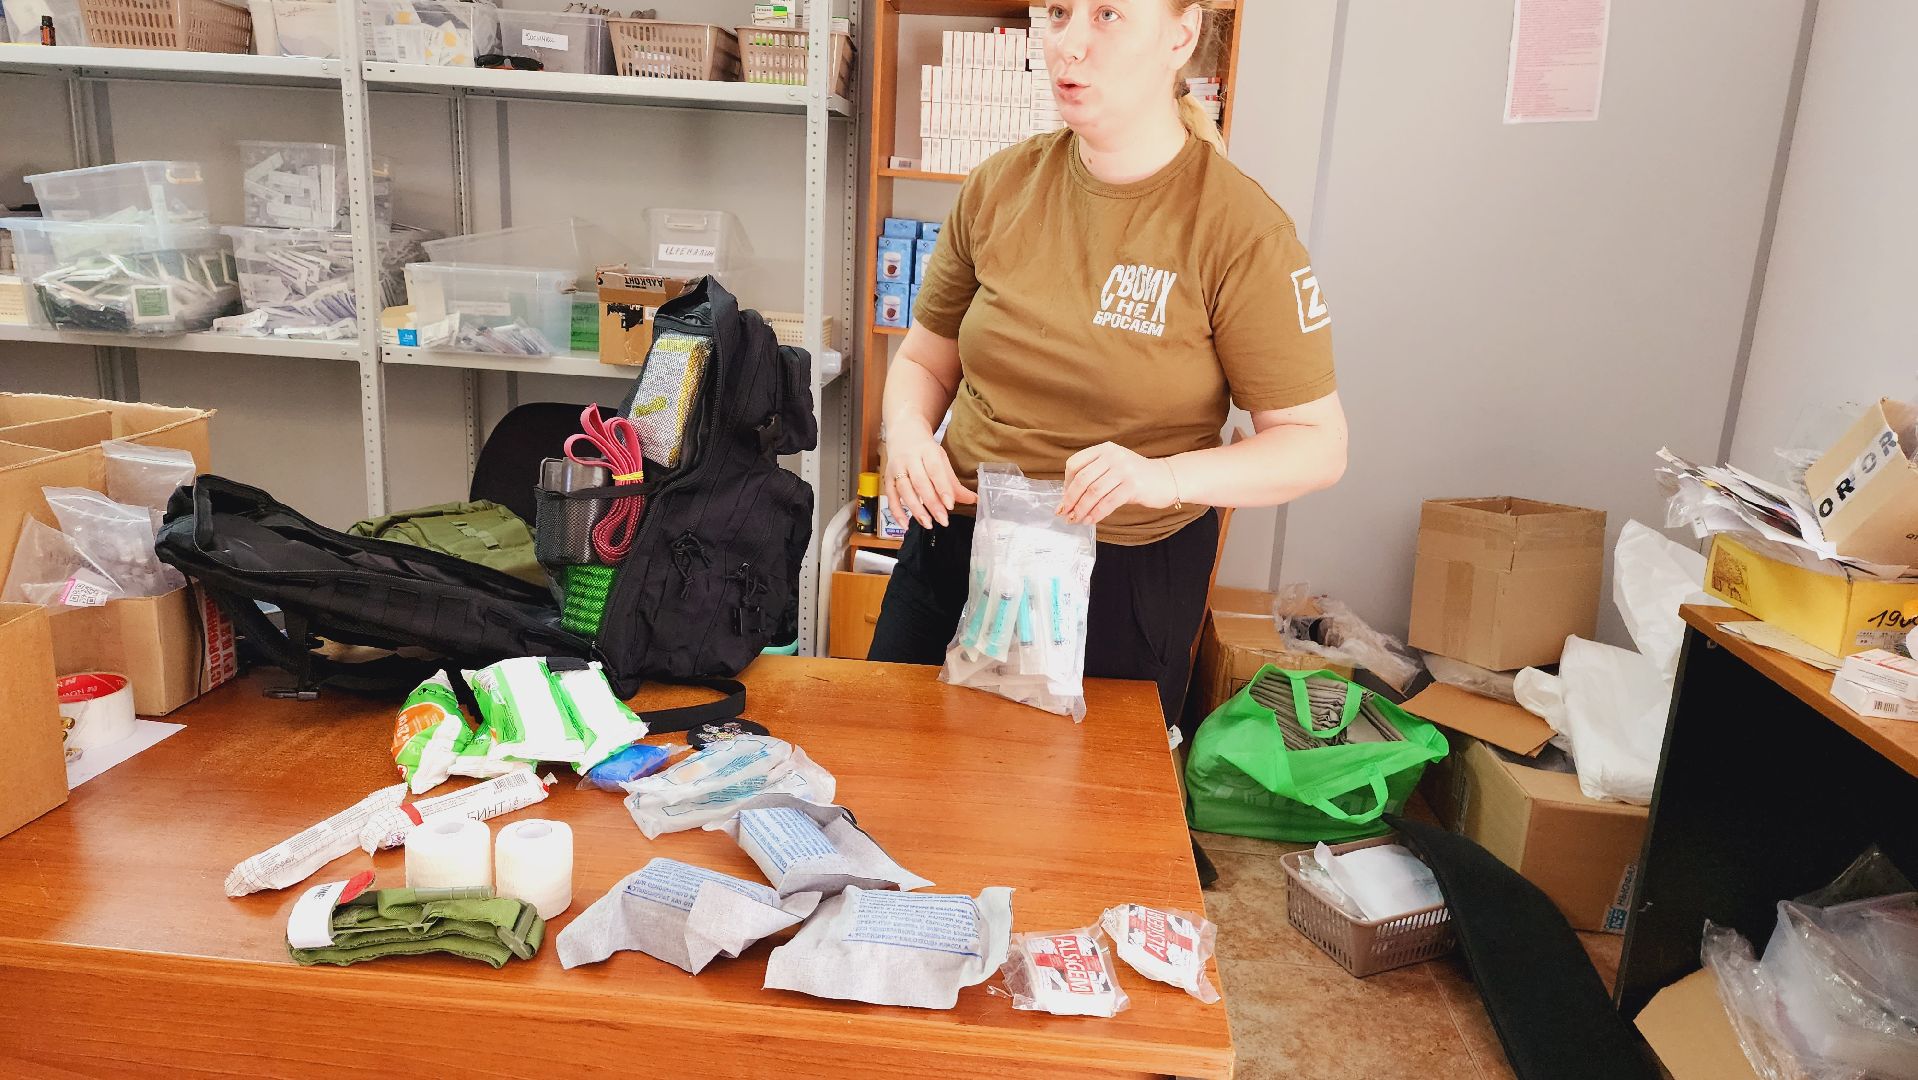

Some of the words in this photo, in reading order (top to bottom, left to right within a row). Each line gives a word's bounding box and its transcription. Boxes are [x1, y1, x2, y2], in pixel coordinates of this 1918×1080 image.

[1100, 265, 1177, 324] СВОИХ
[1116, 299, 1149, 319] НЕ
[1093, 311, 1165, 336] БРОСАЕМ
[467, 800, 506, 821] БИНТ
